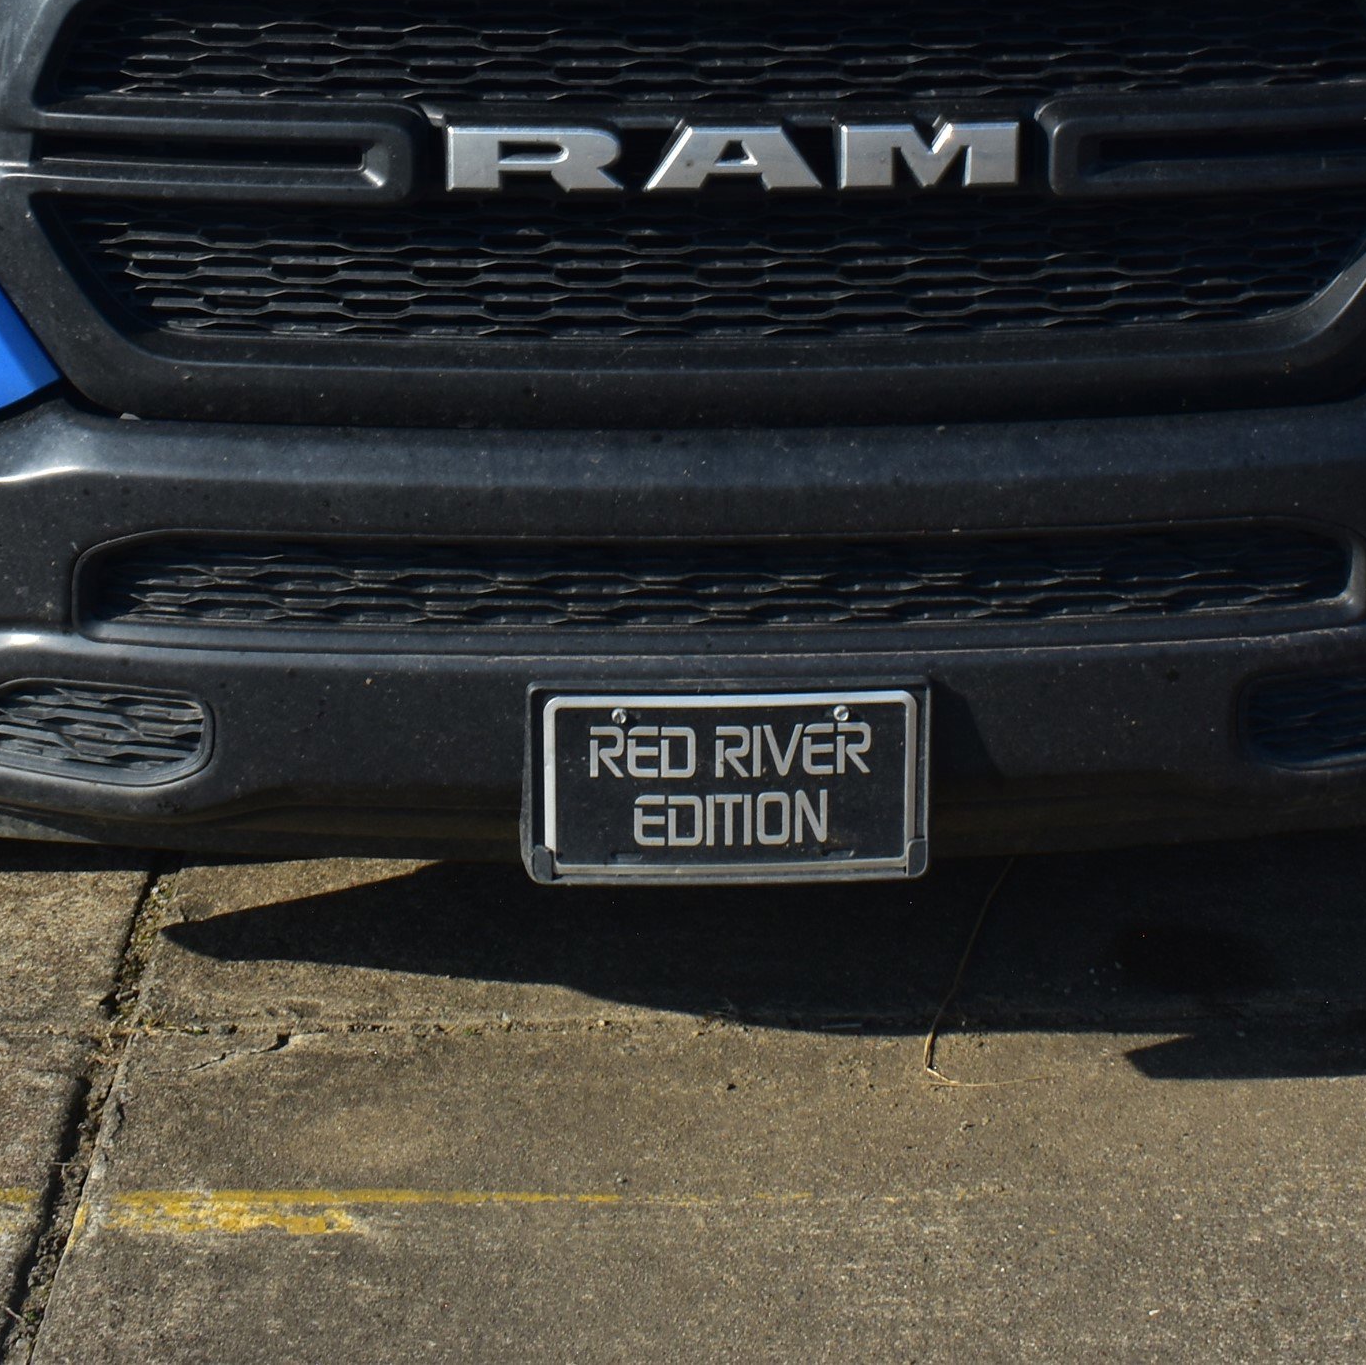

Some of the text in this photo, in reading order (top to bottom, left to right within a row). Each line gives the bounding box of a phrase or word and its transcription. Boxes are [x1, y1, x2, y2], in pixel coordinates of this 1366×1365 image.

[445, 120, 1020, 191] RAM
[589, 721, 872, 779] RED RIVER
[633, 789, 828, 846] EDITION
